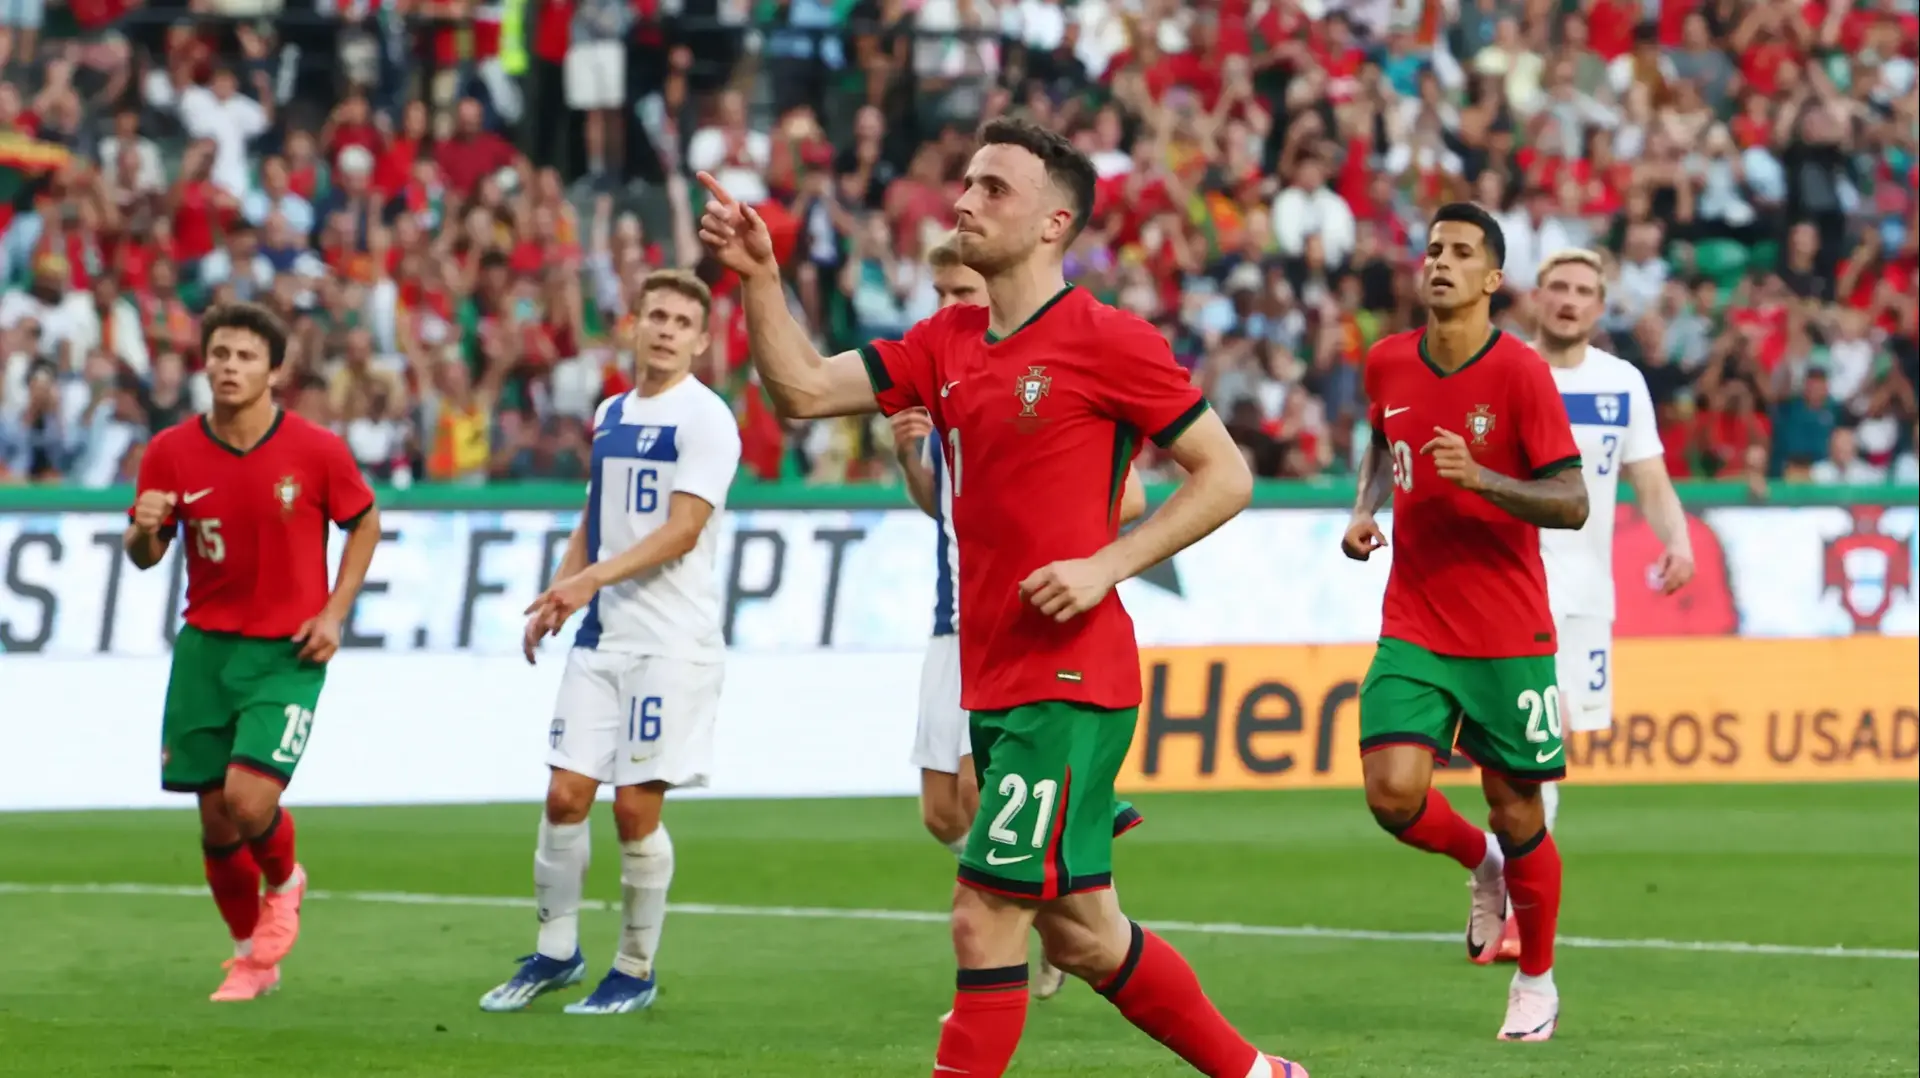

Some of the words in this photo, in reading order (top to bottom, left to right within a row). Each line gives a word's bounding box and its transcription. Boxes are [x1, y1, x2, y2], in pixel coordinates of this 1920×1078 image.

[949, 427, 963, 497] 1
[1392, 440, 1412, 493] 0
[1597, 434, 1617, 475] 3
[626, 467, 658, 513] 16
[189, 518, 225, 562] 15
[1589, 650, 1606, 691] 3
[280, 703, 314, 755] 15
[629, 696, 662, 741] 16
[1142, 661, 1472, 778] Her
[1517, 685, 1562, 743] 20
[988, 773, 1057, 848] 21
